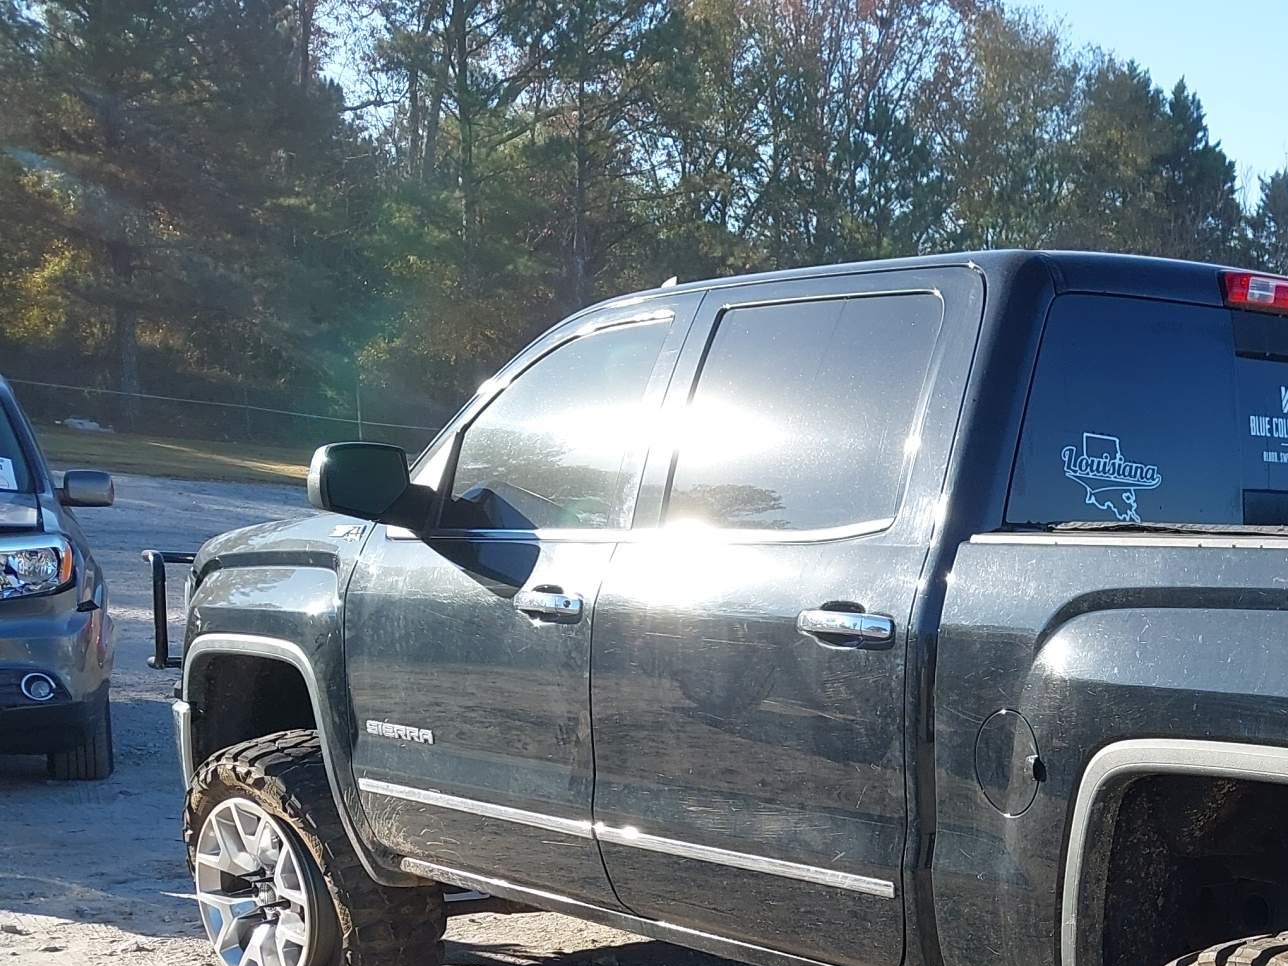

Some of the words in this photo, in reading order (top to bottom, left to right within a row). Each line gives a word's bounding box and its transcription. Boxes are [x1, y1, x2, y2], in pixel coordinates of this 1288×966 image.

[1250, 415, 1271, 437] BLUE
[1061, 446, 1160, 485] Louisiana
[366, 719, 435, 745] SIERRA
